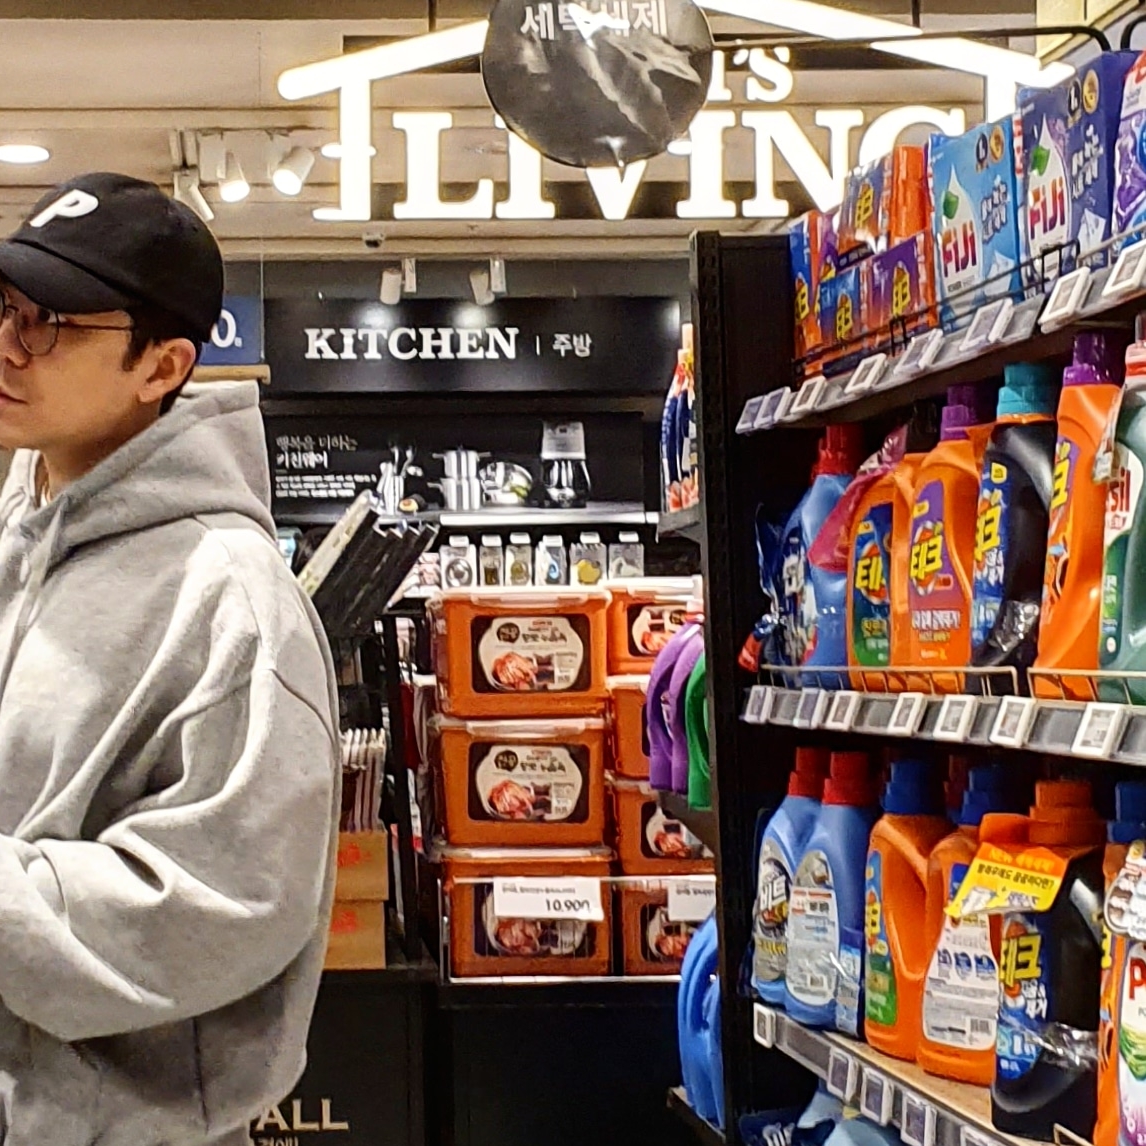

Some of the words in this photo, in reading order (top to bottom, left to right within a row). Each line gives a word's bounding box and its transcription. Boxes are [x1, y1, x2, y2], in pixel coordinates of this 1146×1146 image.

[519, 0, 670, 40] 세제
[30, 189, 99, 228] P
[304, 327, 520, 360] KITCHEN
[552, 333, 592, 357] 주방
